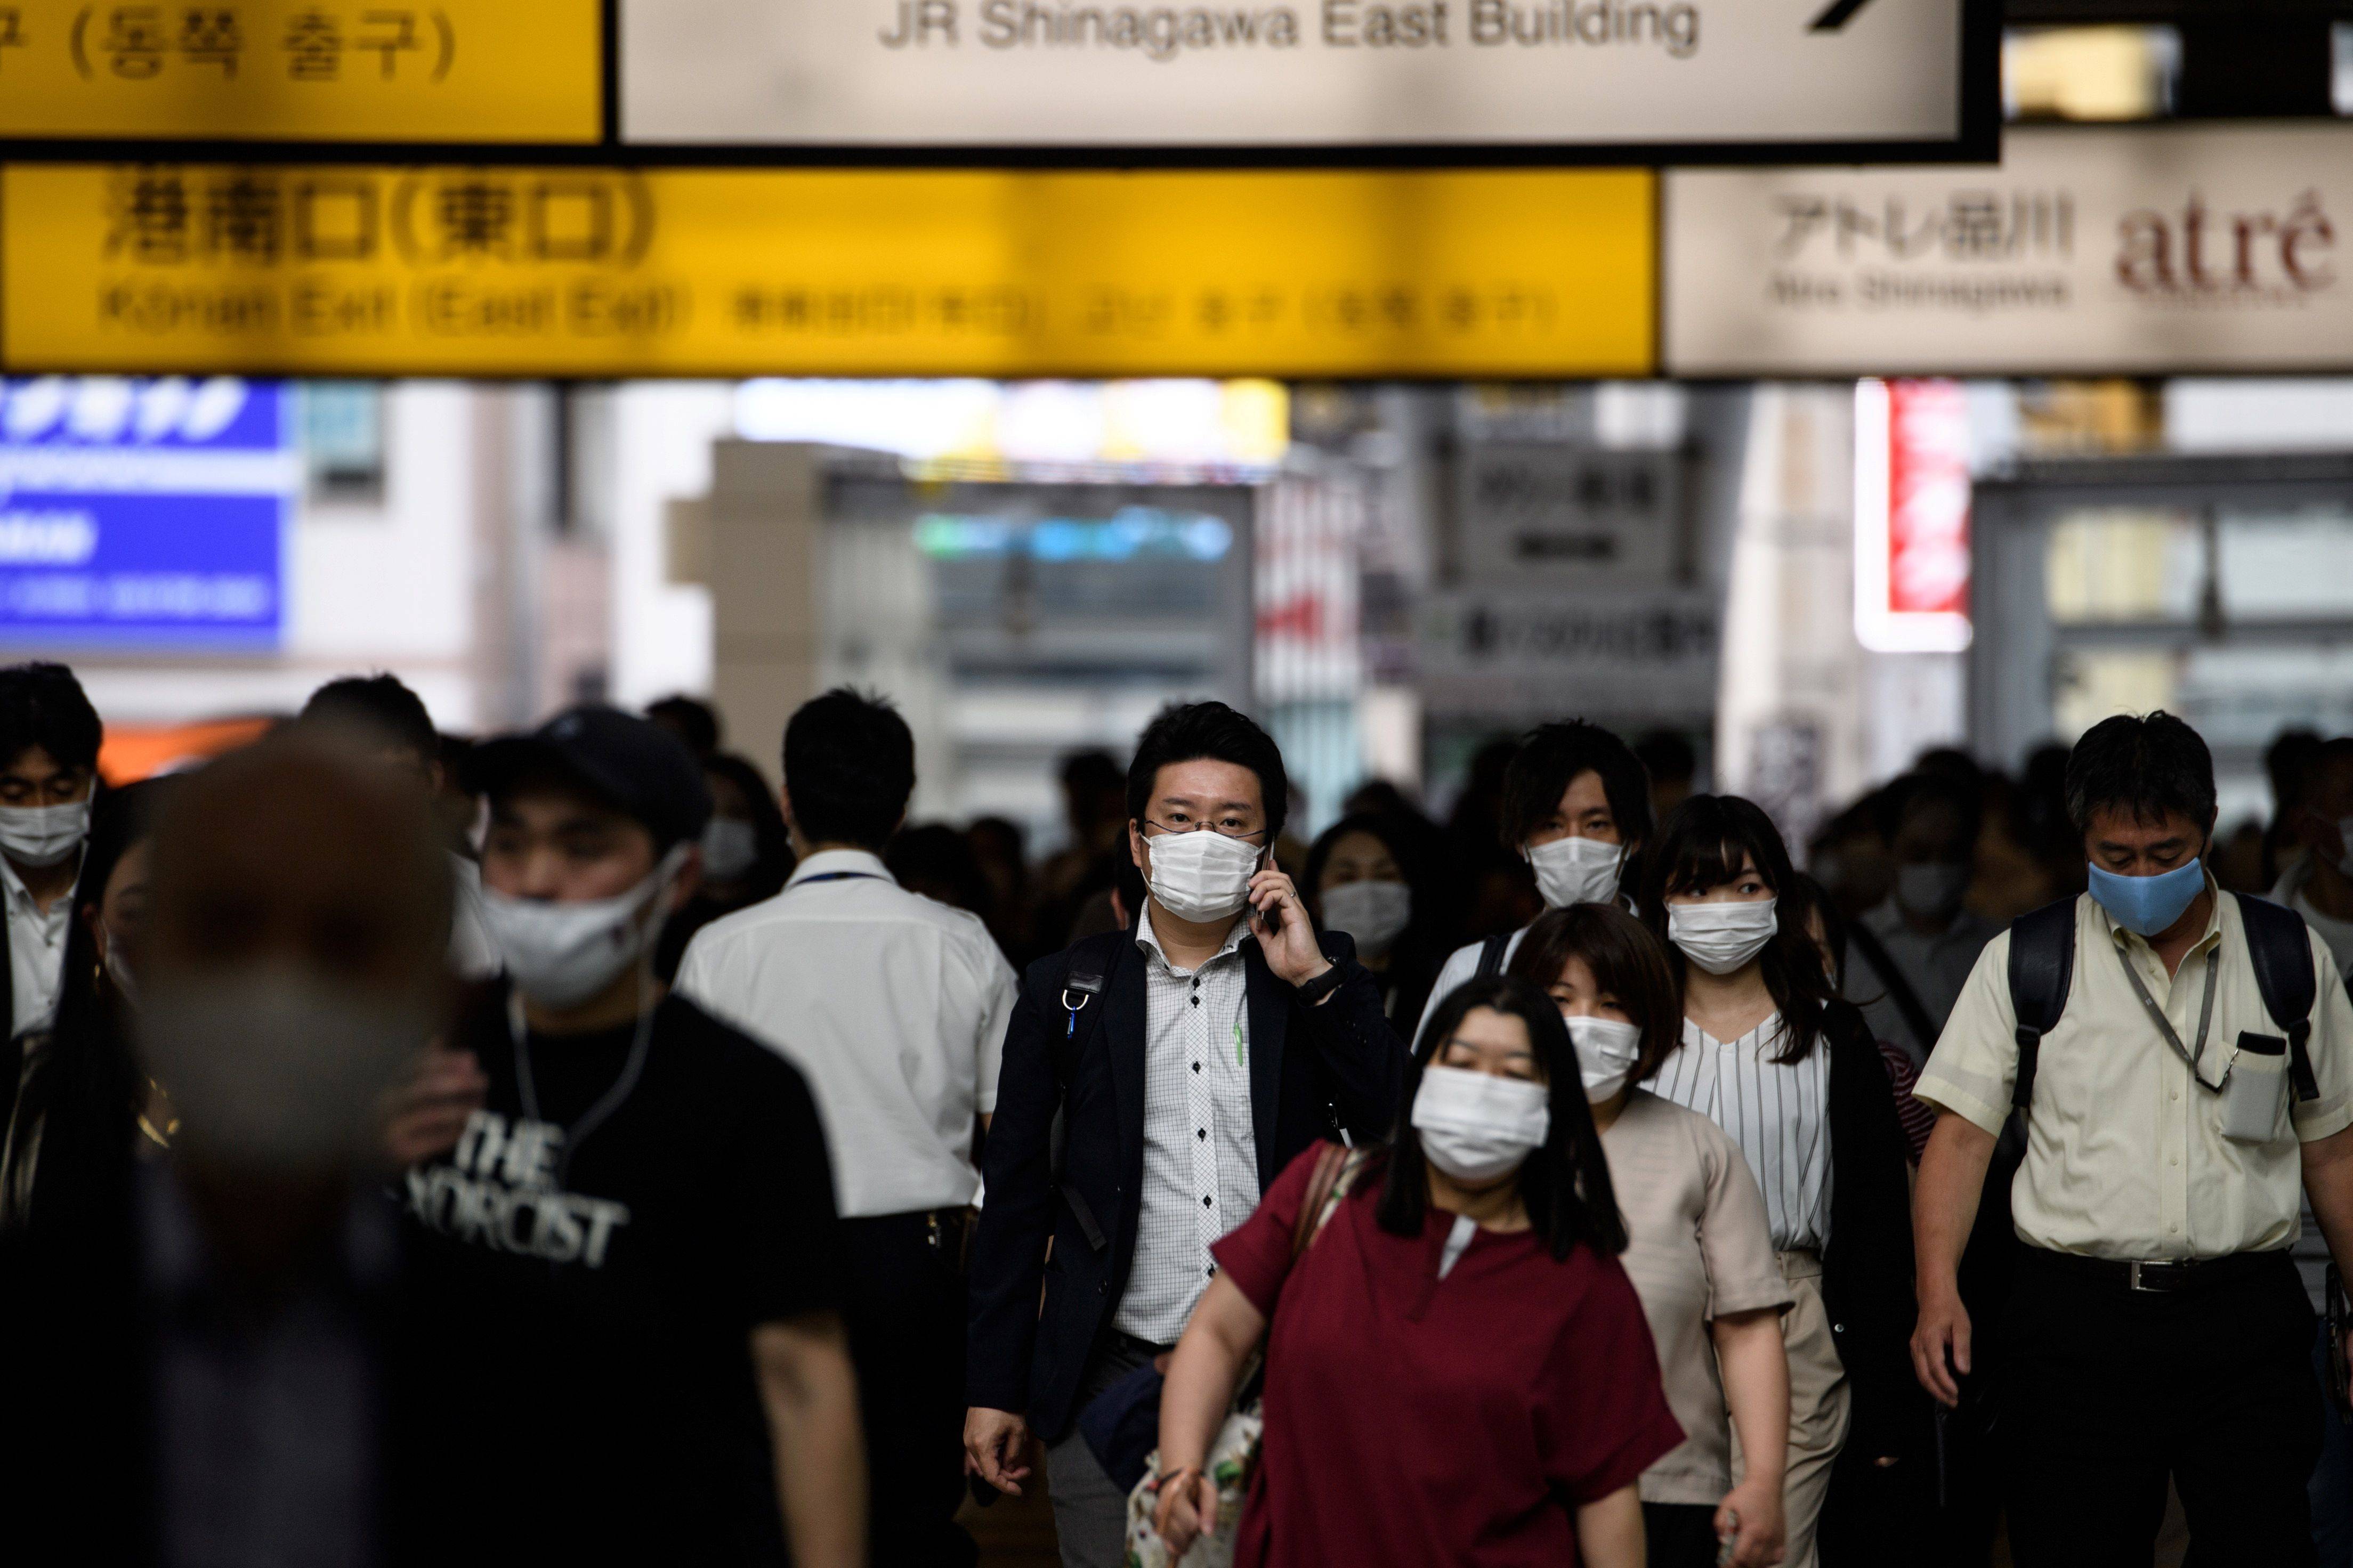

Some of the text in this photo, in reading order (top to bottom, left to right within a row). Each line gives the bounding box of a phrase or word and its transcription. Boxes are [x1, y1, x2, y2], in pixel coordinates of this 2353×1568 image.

[877, 0, 1700, 63] JR Shinagawa East Building
[405, 1165, 632, 1269] XORCIST
